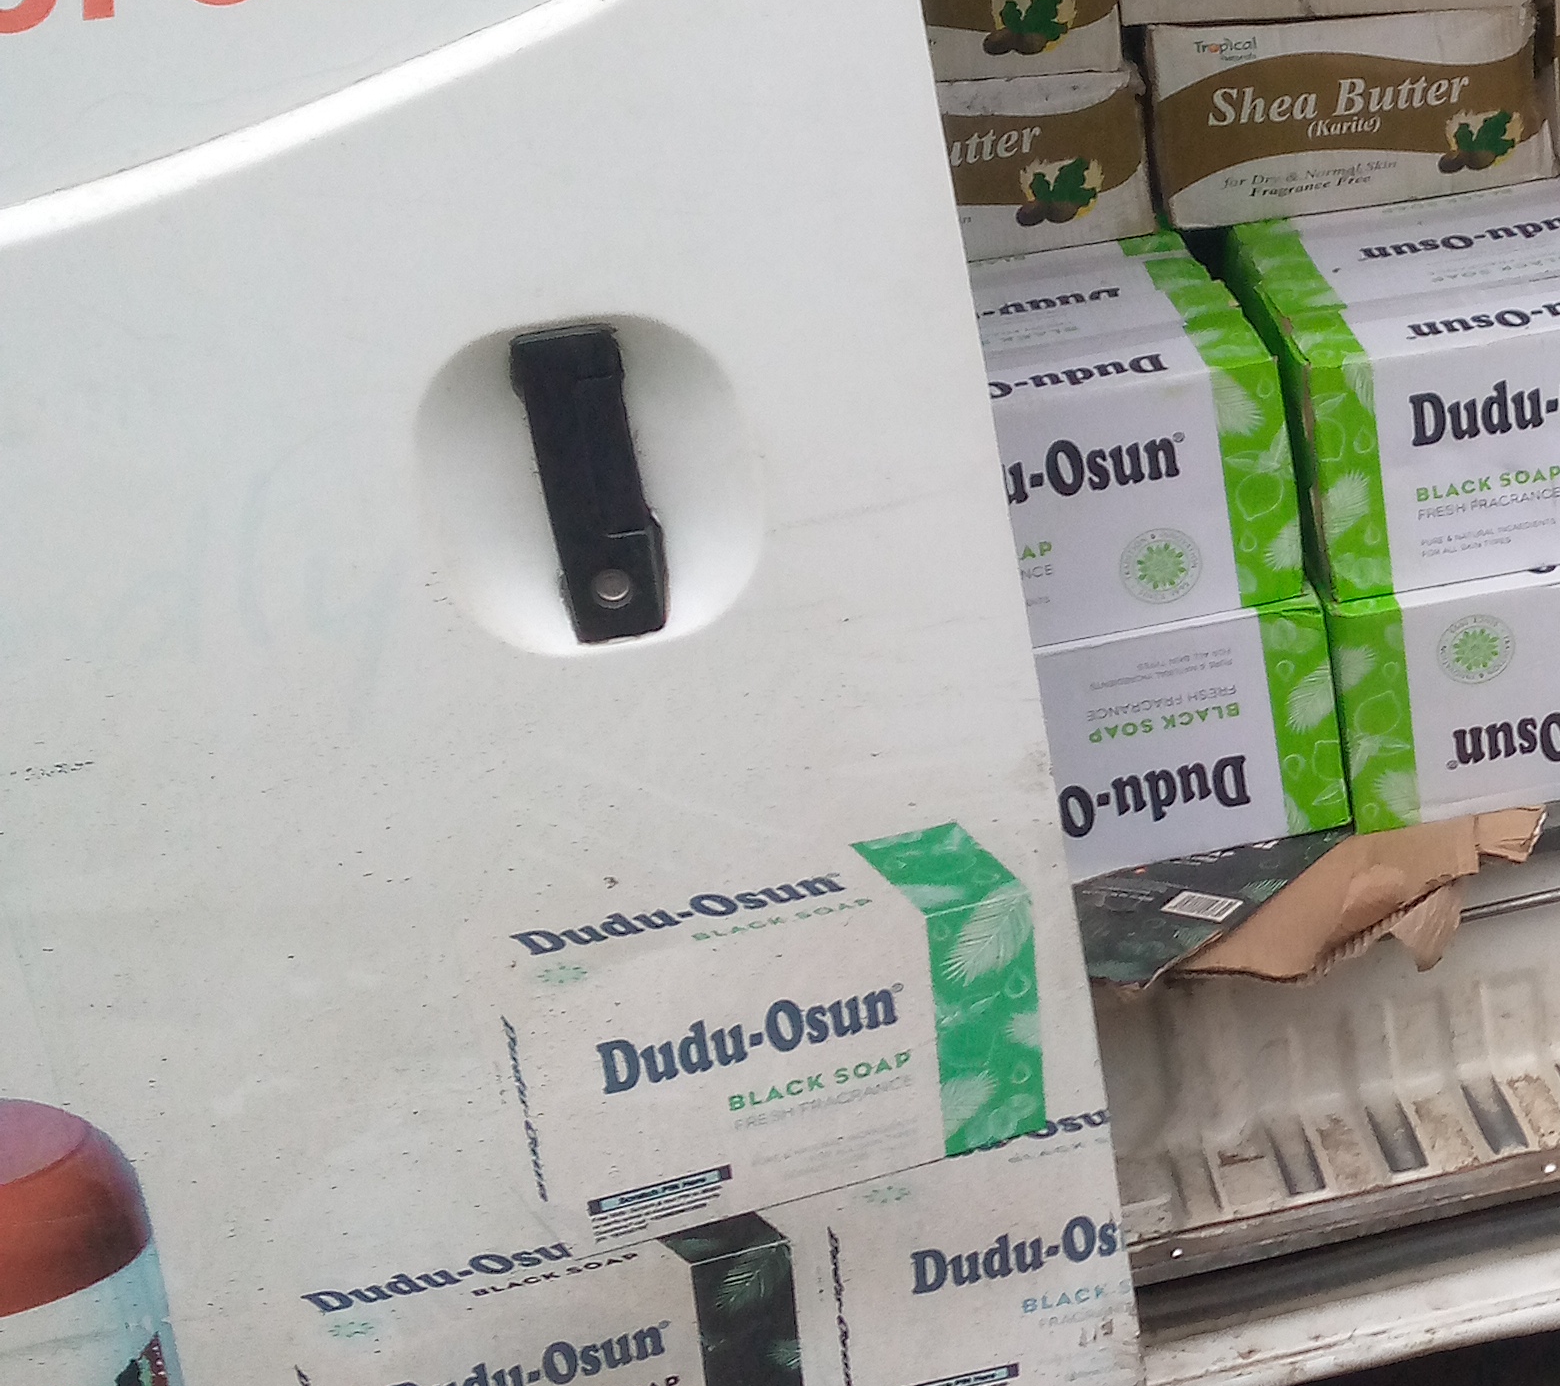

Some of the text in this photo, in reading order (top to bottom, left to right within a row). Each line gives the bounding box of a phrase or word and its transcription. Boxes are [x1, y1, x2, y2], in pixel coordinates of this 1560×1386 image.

[1194, 35, 1258, 55] Tropical
[1207, 76, 1470, 128] Shea Butter
[1221, 175, 1248, 191] for
[1303, 164, 1361, 182] Normal
[1364, 158, 1398, 174] Skin
[1249, 174, 1372, 198] Fragrance Free
[1415, 474, 1492, 503] BLACK
[1417, 500, 1466, 521] FRESH
[1085, 685, 1237, 721] FRESH FRAGRANCE
[1087, 701, 1241, 744] BLACK SOAP
[1057, 754, 1251, 839] Dudu-O
[510, 872, 848, 956] Dudu-Osun
[691, 897, 875, 942] BLACK SOAP
[597, 982, 905, 1095] Dudu-Osun
[727, 1050, 912, 1112] BLACK SOAP
[471, 1252, 639, 1297] BLACK SOAP
[1021, 1283, 1109, 1315] BLACK
